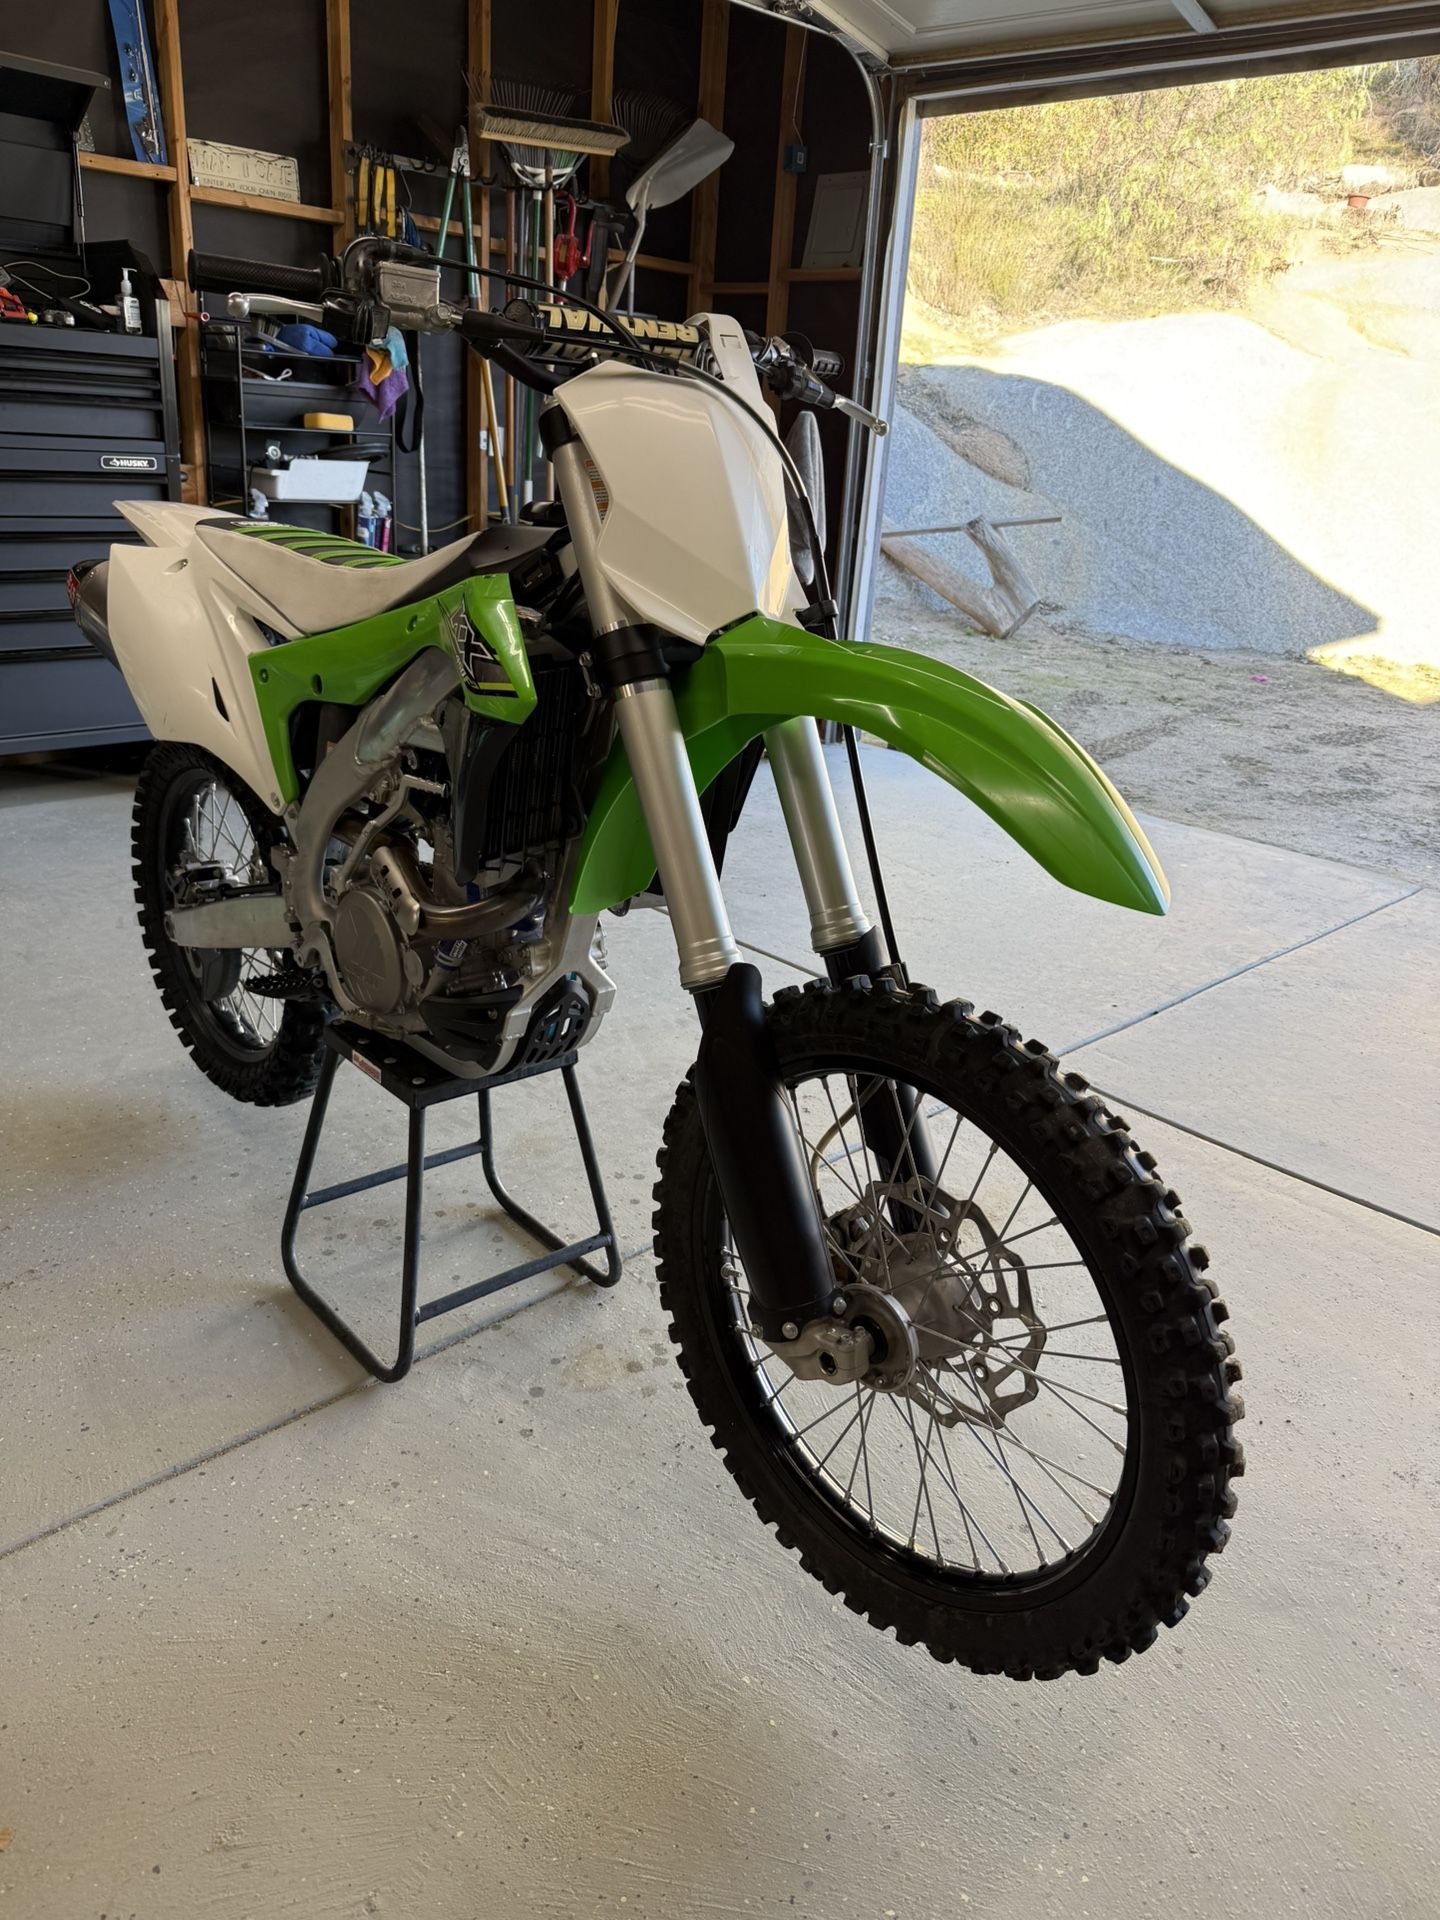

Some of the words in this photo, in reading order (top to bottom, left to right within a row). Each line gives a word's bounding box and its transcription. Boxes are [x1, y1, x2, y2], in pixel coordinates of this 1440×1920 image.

[227, 182, 236, 190] AT
[259, 188, 276, 197] OWN
[120, 459, 148, 467] HUSKY
